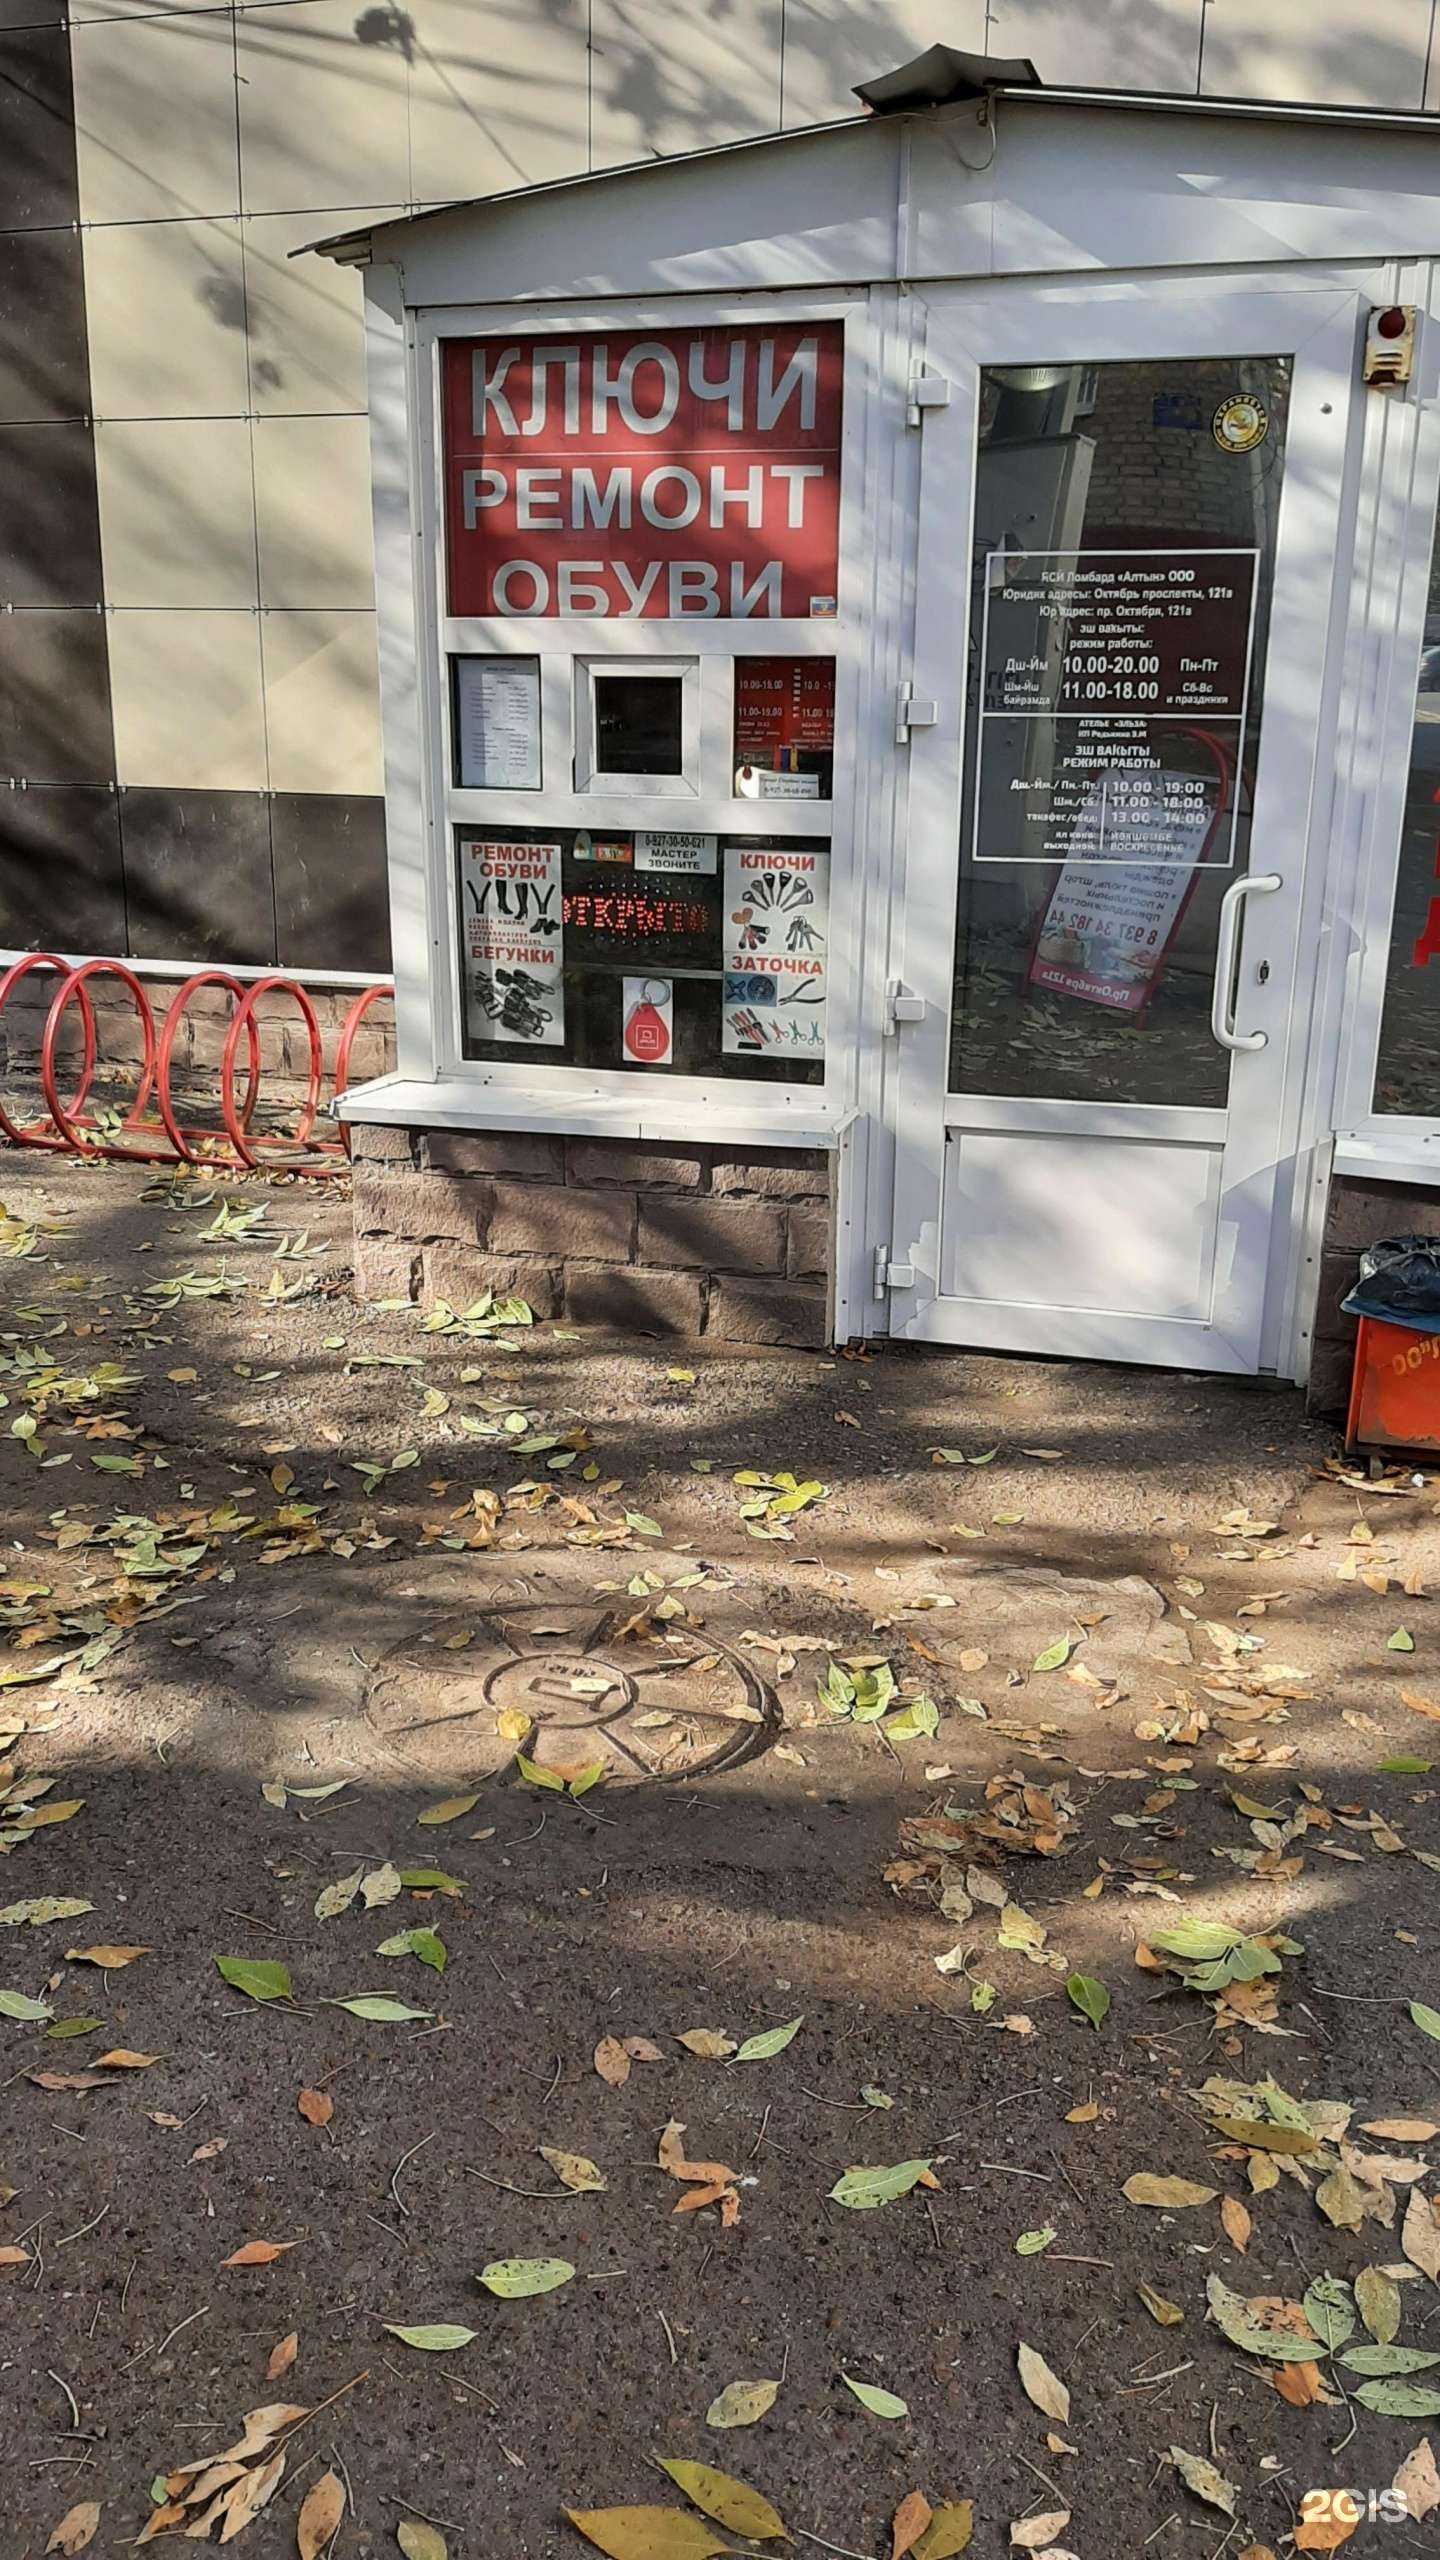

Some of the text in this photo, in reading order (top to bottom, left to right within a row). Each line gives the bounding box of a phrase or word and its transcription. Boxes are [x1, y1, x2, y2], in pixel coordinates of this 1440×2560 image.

[471, 337, 819, 437] КЛЮЧИ
[461, 465, 824, 530] РЕМОНТ
[1066, 571, 1115, 584] Ломбард
[1168, 570, 1195, 582] ООО
[491, 559, 784, 619] ОБУВИ
[1094, 587, 1140, 601] Октябрь
[1096, 607, 1113, 619] пр.
[1116, 605, 1164, 618] Октября,
[1168, 604, 1193, 617] 121а
[1080, 623, 1096, 633] эш
[1070, 638, 1153, 652] режим работы:
[1005, 655, 1220, 674] Дш-Йм 10.00-20.00 Пн-Пт
[1004, 679, 1214, 699] Шм-Йш 11.00-18.00 Сб-Вс
[1166, 695, 1174, 704] и
[1175, 695, 1229, 706] праздники
[1078, 719, 1110, 727] АТЕЛЬЕ
[1074, 745, 1095, 756] ЭШ
[1062, 757, 1161, 768] РЕЖИМ РАБОТЫ
[1112, 780, 1151, 794] 10.00
[1164, 781, 1205, 794] 19:00
[1111, 796, 1149, 808] 11.00
[1162, 797, 1204, 809] 18:00
[1111, 811, 1149, 824] 13.00
[1164, 812, 1205, 825] 14:00
[470, 844, 555, 864] РЕМОНТ
[651, 848, 697, 860] МАСТЕР
[648, 859, 701, 870] ЗВОНИТЕ
[739, 853, 816, 872] КЛЮЧИ
[479, 861, 548, 880] ОБУВИ
[471, 945, 555, 965] БЕГУНКИ
[731, 956, 824, 976] ЗАТОЧКА
